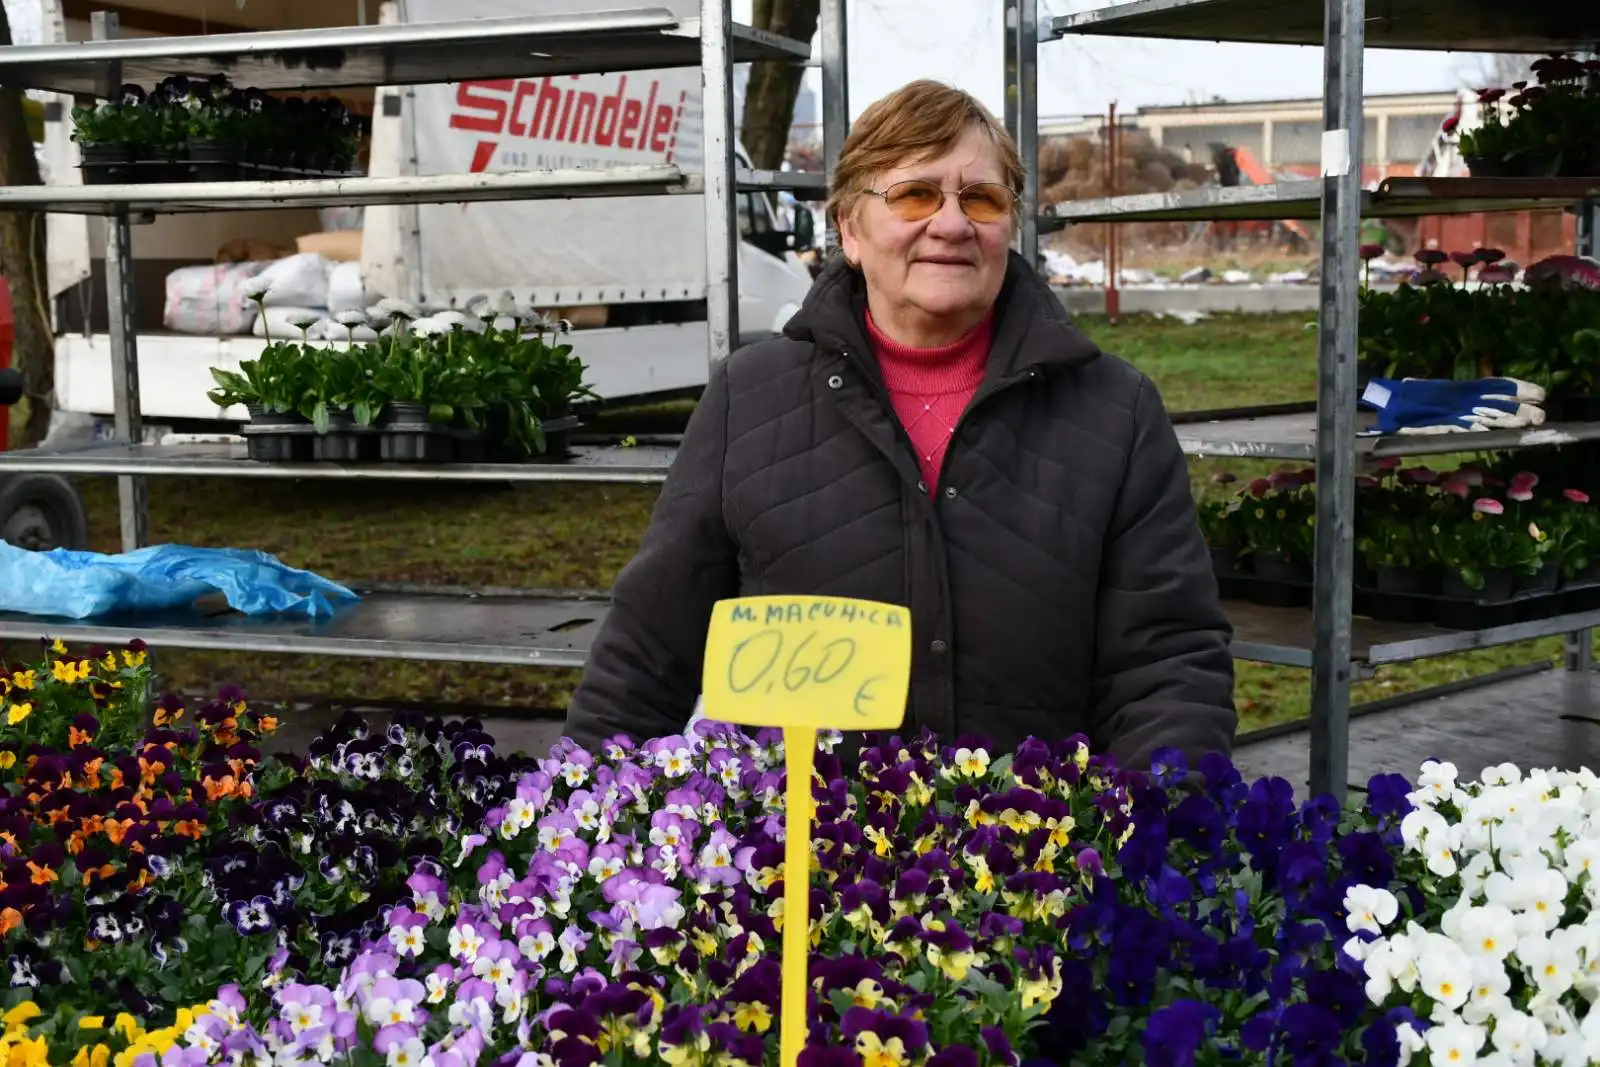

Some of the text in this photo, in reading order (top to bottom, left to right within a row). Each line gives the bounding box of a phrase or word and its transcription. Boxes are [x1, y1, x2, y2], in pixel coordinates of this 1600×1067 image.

[449, 76, 674, 152] Schindele
[731, 605, 757, 622] M.
[729, 630, 887, 716] 0,60 €
